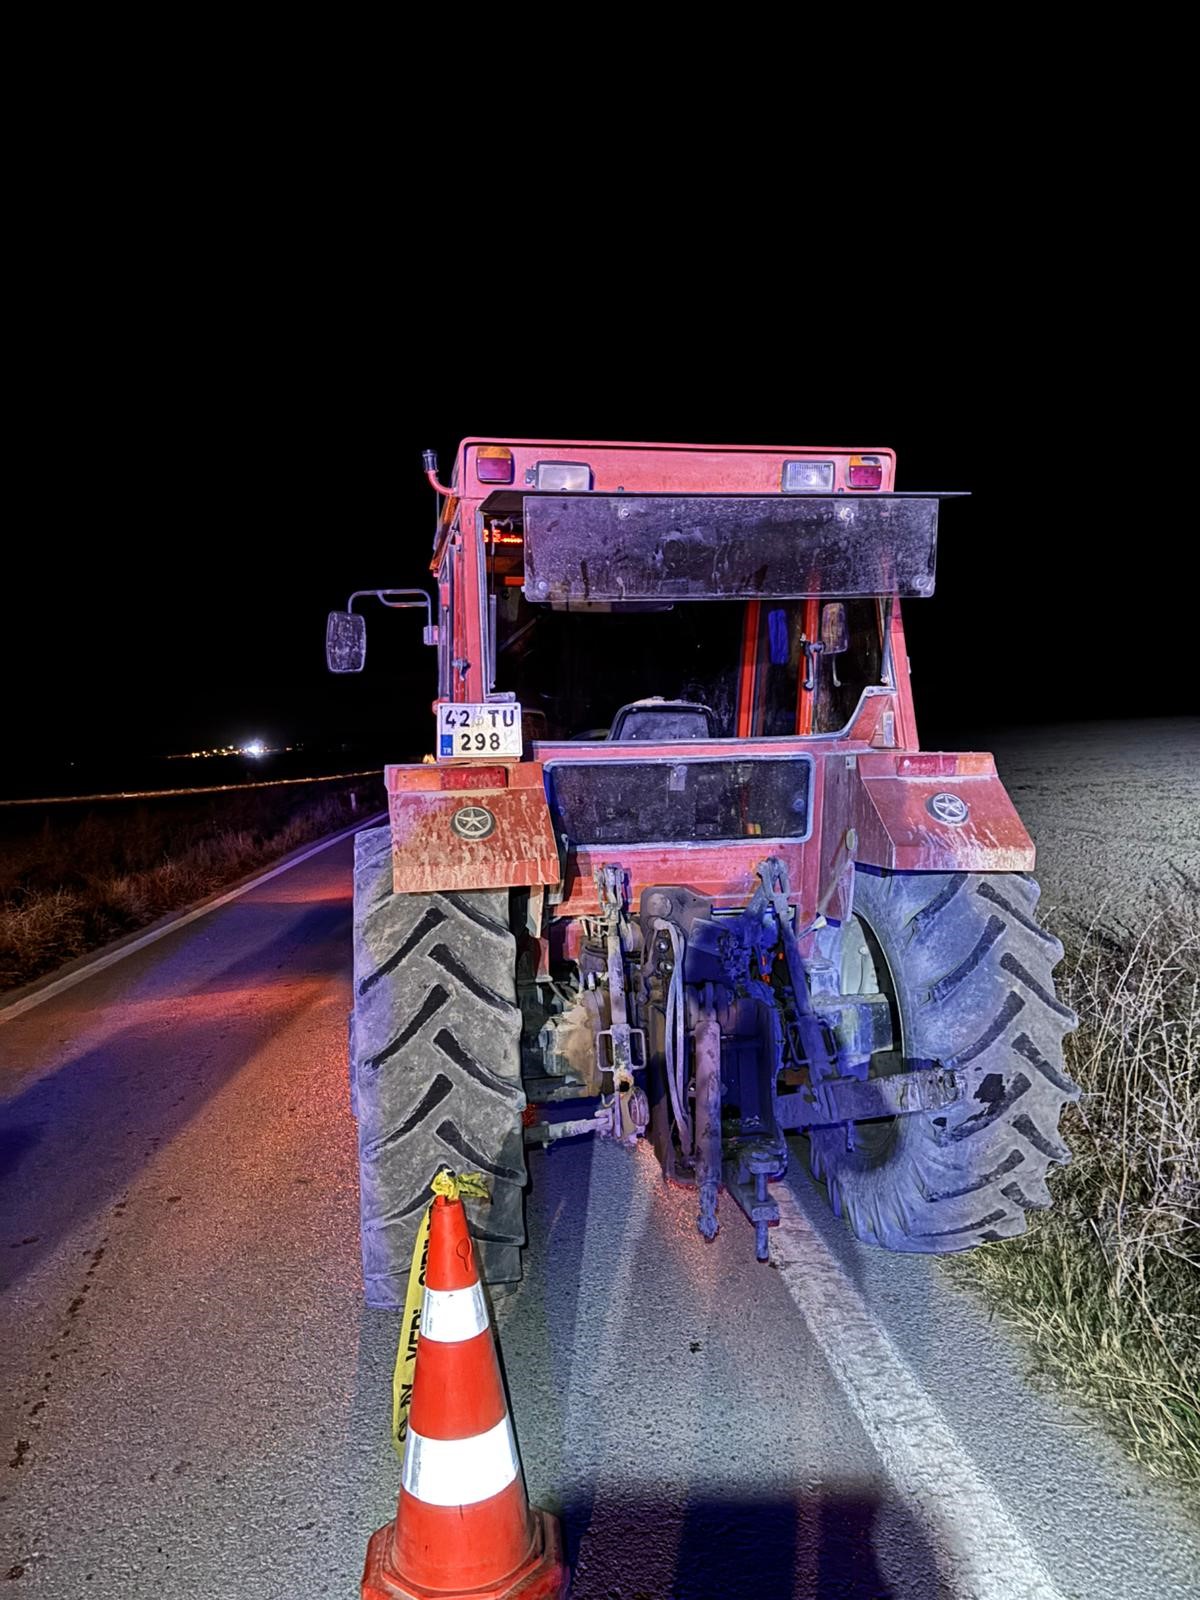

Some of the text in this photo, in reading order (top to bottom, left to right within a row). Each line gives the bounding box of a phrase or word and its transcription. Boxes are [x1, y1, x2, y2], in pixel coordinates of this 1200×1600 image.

[445, 709, 514, 728] 42 TU
[461, 733, 500, 751] 298
